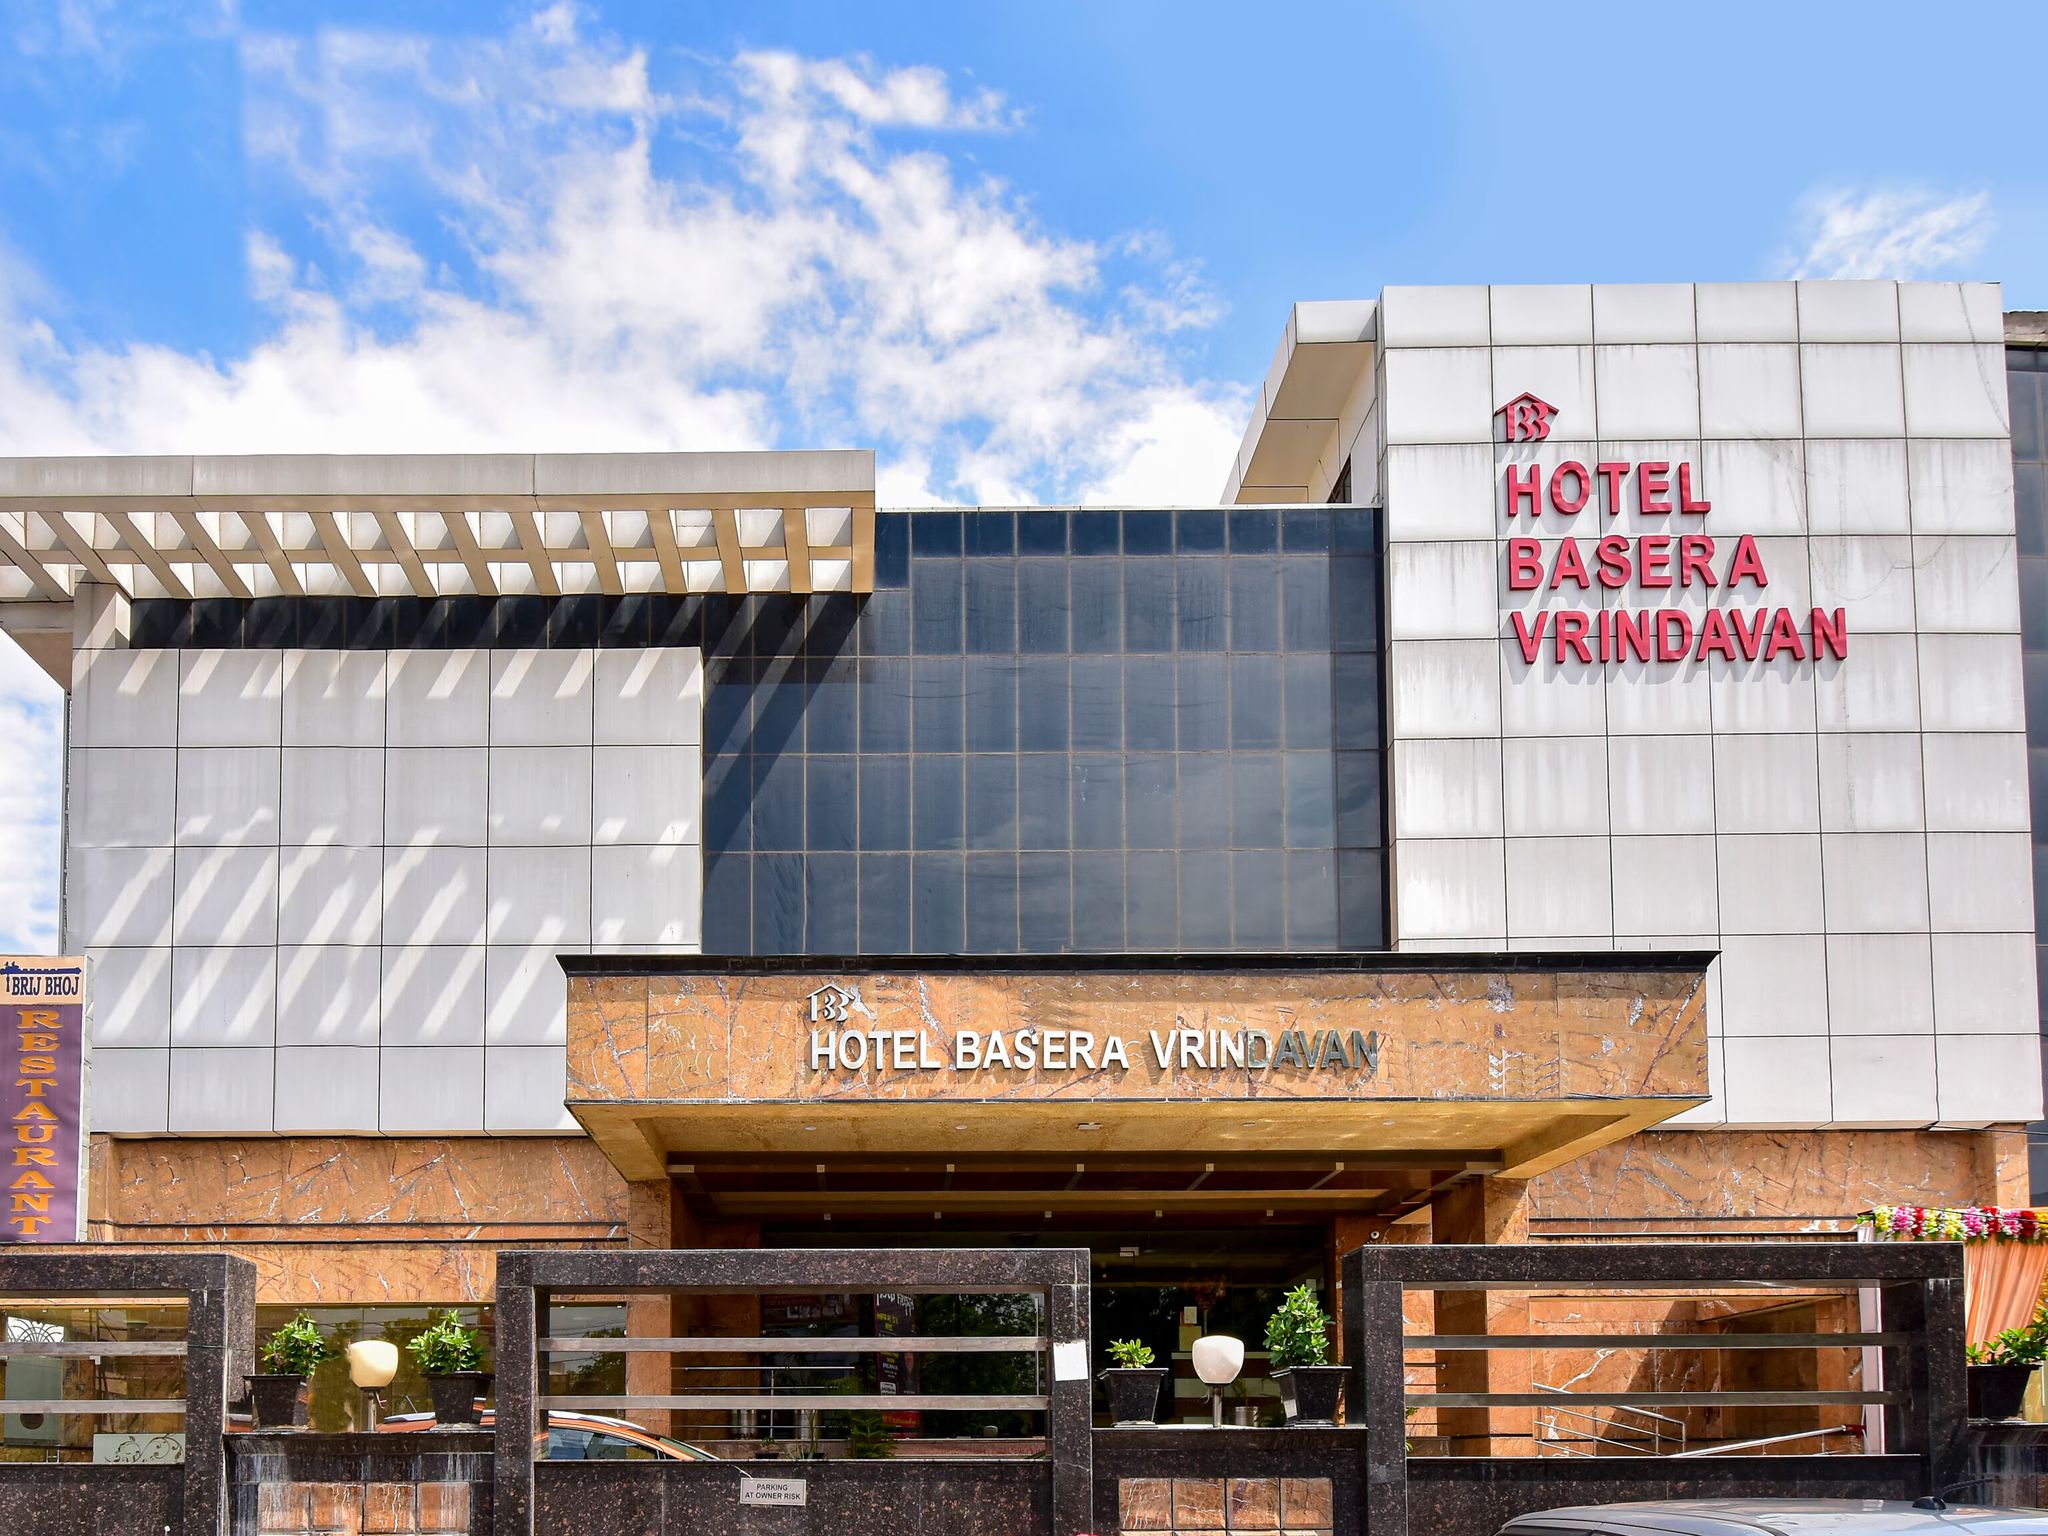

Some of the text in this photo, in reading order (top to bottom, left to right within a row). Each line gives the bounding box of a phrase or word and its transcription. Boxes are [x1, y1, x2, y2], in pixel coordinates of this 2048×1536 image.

[1507, 460, 1712, 517] HOTEL
[1508, 534, 1769, 591] BASERA
[1510, 607, 1848, 665] VRINDAVAN
[12, 976, 79, 996] BRIJ BHOJ
[811, 1029, 1378, 1070] HOTEL BASERA VRINDAVAN
[9, 1009, 63, 1235] RESTAURANT
[756, 1483, 788, 1491] PARKING
